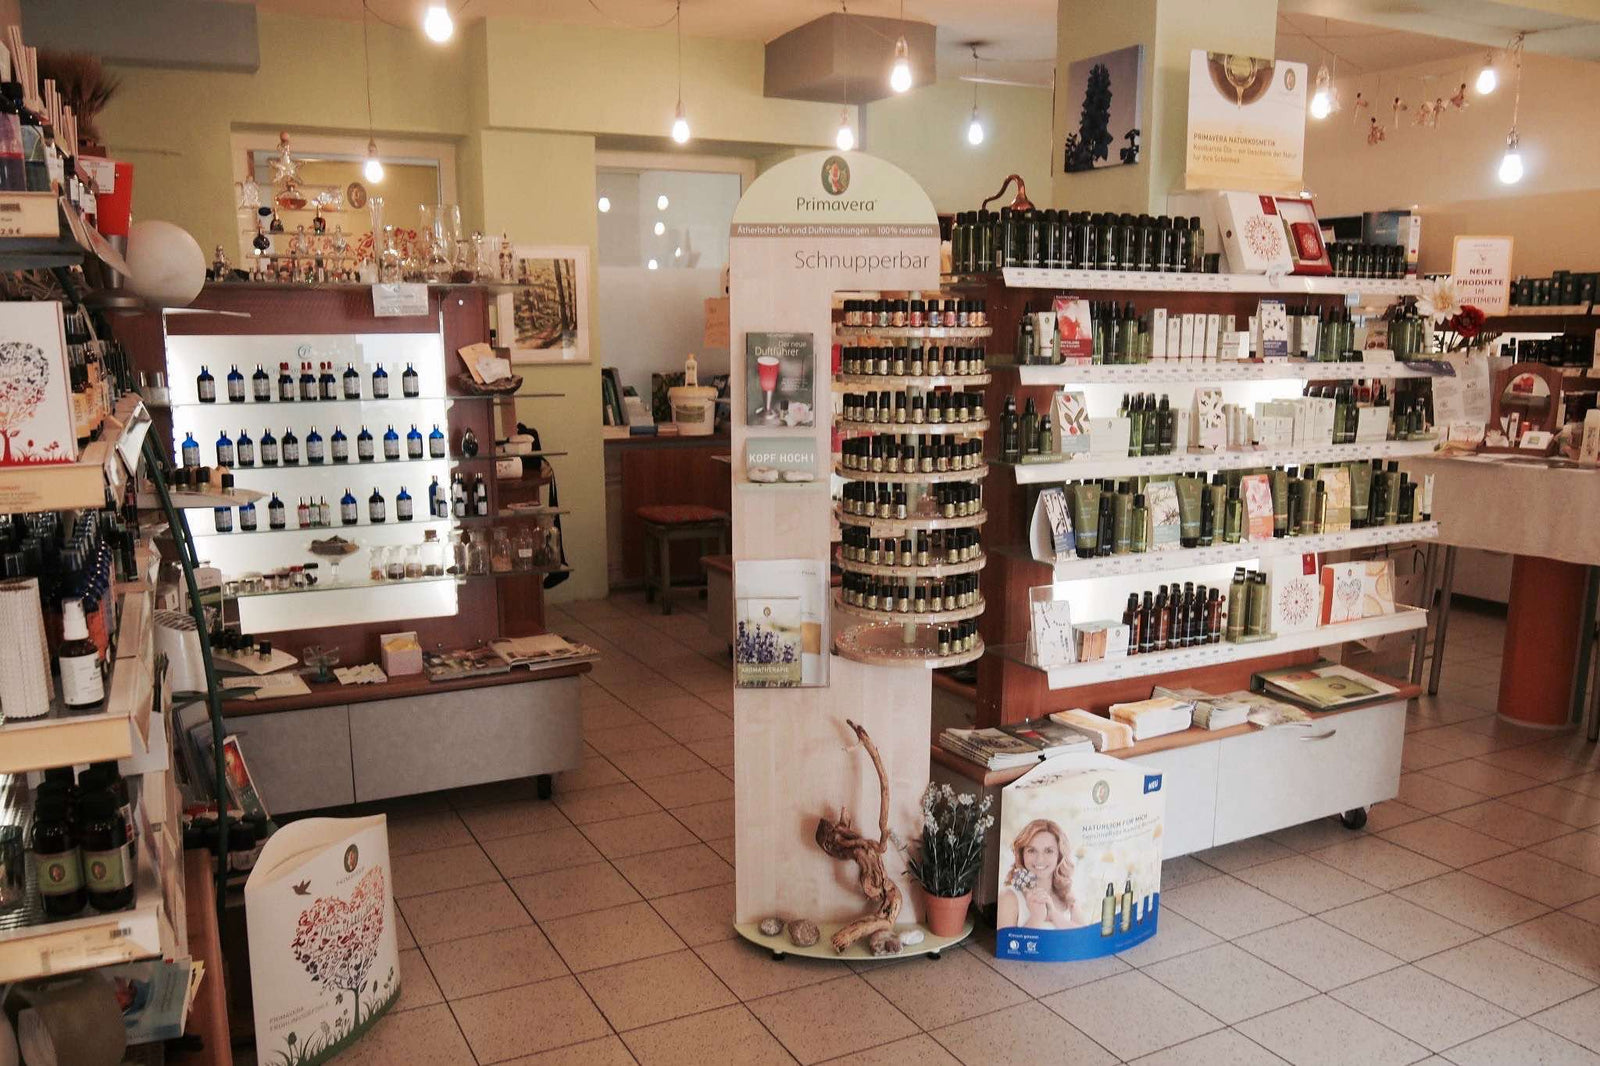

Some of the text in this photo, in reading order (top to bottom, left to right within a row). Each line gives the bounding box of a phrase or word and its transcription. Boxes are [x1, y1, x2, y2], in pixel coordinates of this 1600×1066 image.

[796, 196, 875, 212] Primavera
[737, 225, 776, 235] Ätherische
[778, 225, 791, 235] Öle
[792, 226, 807, 235] und
[808, 226, 870, 237] Duftmischungen
[899, 226, 933, 235] naturrein
[795, 250, 930, 272] Schnupperbar
[748, 453, 776, 463] KOPF
[1148, 780, 1159, 790] NEU
